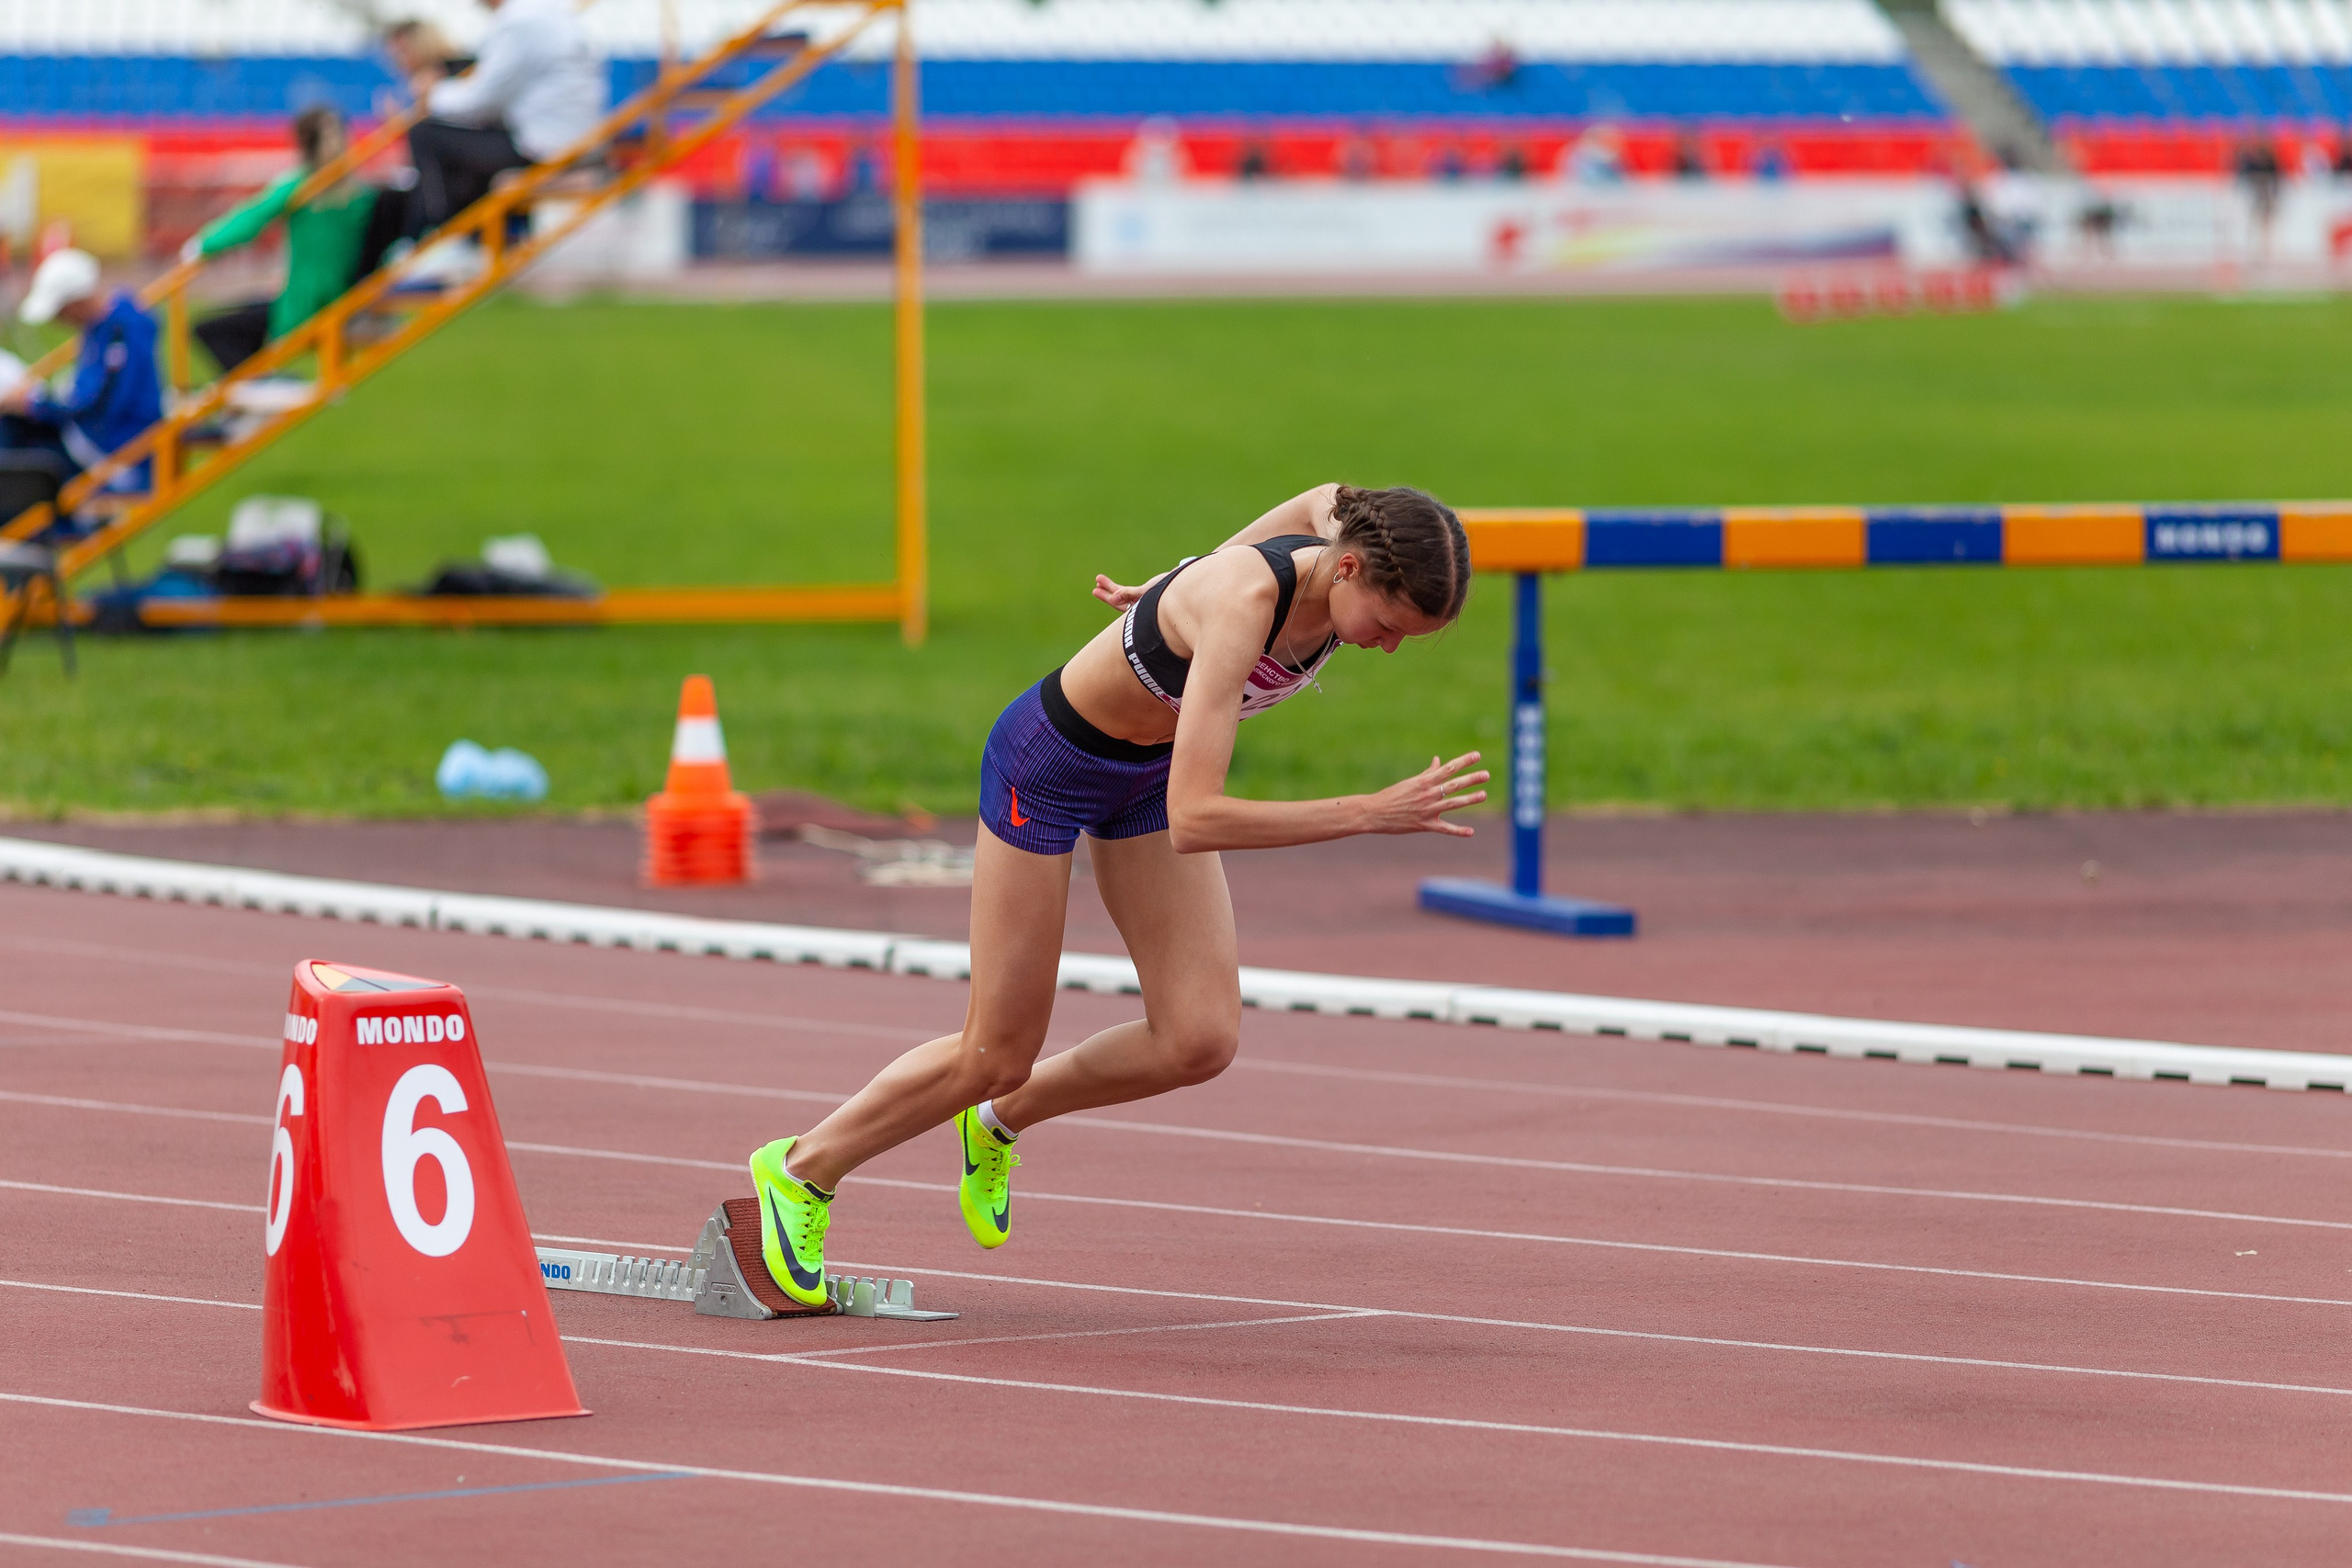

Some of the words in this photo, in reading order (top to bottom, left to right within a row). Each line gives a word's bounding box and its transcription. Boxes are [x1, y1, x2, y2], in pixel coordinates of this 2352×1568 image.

[1128, 652, 1164, 695] PUMA
[356, 1014, 465, 1044] MONDO
[266, 1064, 304, 1257] 6
[381, 1064, 475, 1257] 6
